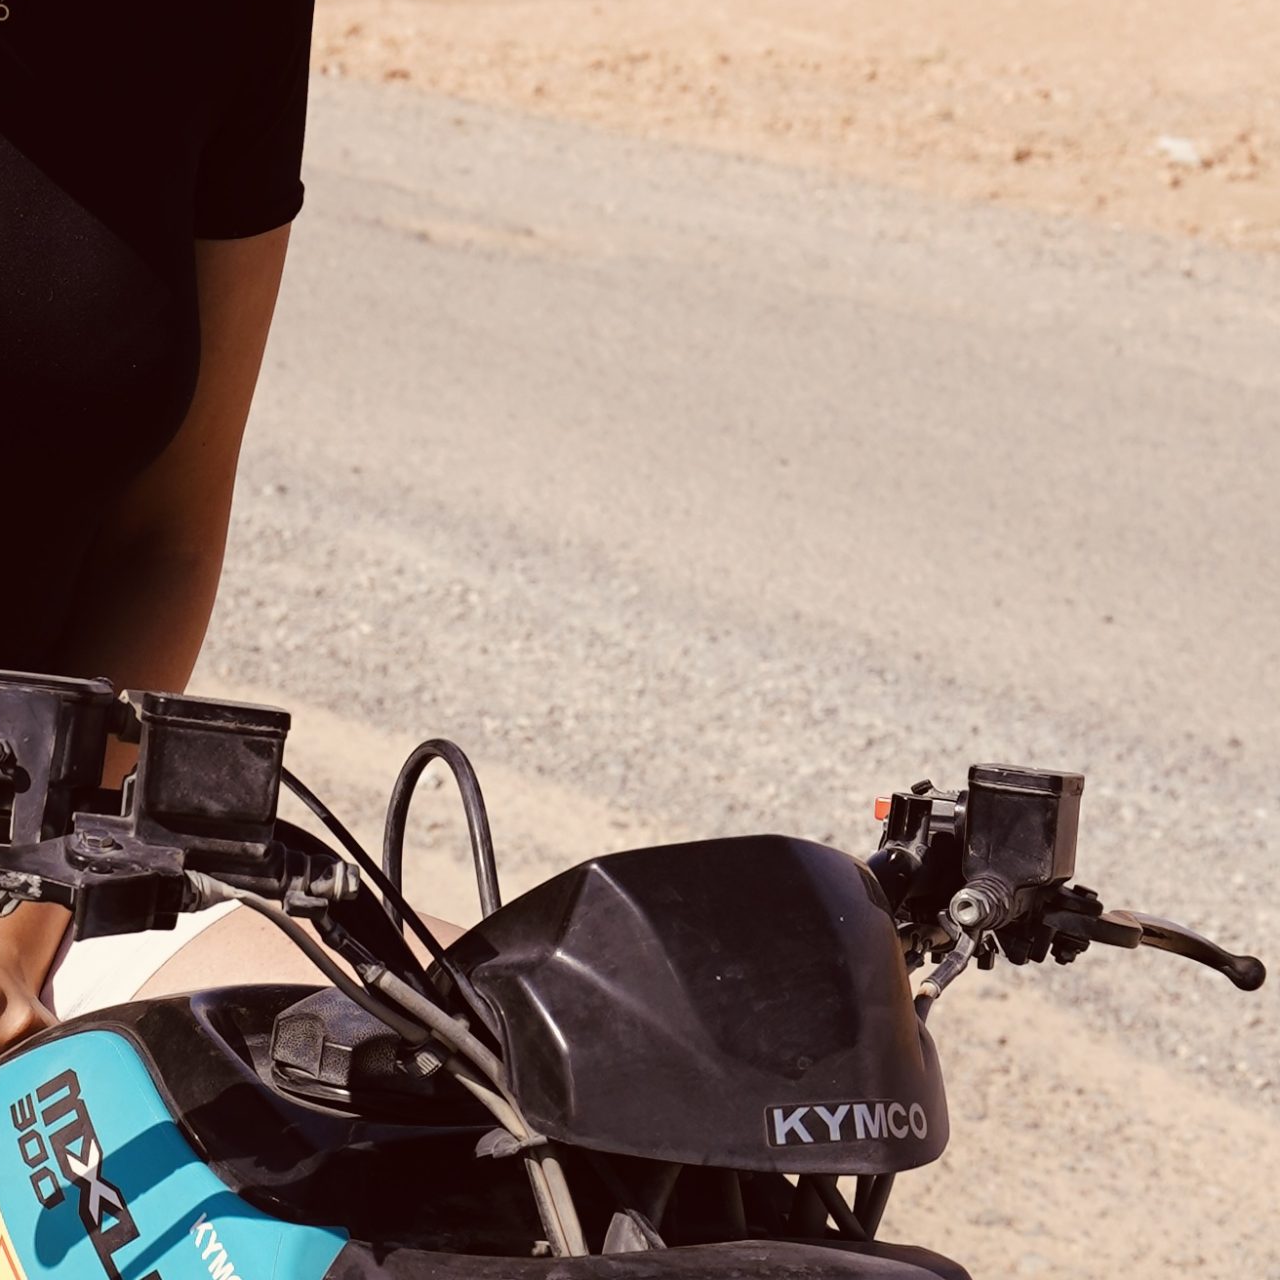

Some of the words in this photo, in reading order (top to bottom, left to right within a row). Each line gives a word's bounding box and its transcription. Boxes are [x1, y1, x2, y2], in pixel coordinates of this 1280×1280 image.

[10, 1093, 66, 1209] 300
[772, 1101, 928, 1145] KYMCO
[189, 1212, 243, 1280] KYM
